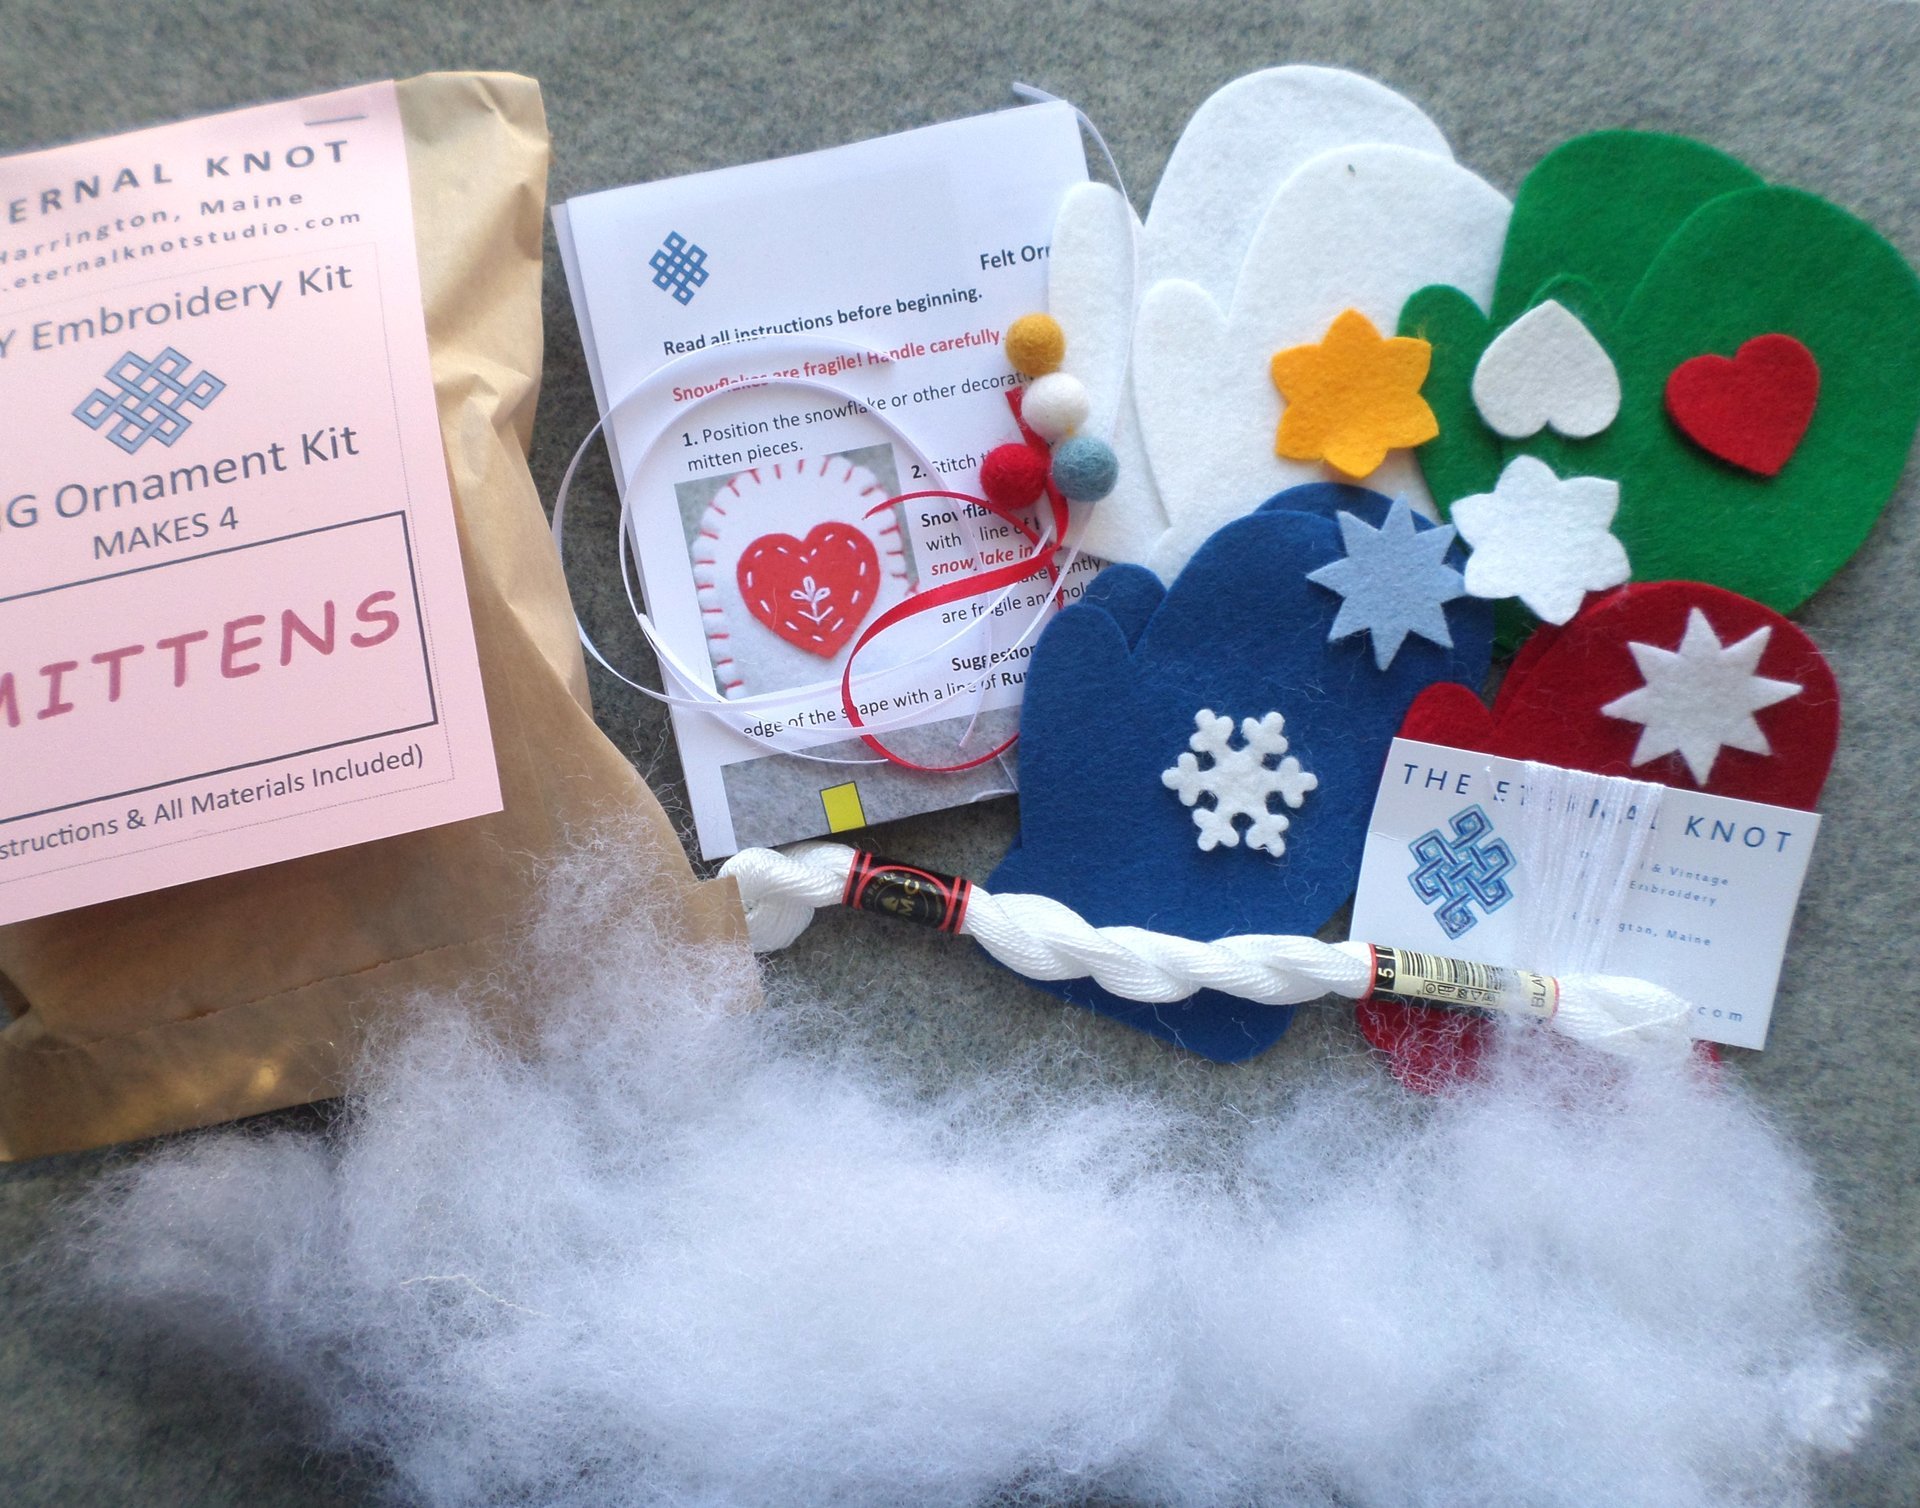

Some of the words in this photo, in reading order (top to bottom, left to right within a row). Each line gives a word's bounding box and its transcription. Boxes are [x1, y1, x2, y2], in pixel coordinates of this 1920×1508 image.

[206, 140, 347, 178] KNOT
[200, 192, 303, 216] Maine
[980, 249, 1016, 270] Felt
[33, 280, 283, 351] Embroidery
[300, 265, 353, 296] Kit
[664, 335, 706, 356] Read
[711, 330, 730, 346] all
[735, 314, 833, 343] instructions
[837, 305, 892, 324] before
[896, 286, 983, 315] beginning.
[803, 353, 862, 378] fragile!
[682, 432, 698, 447] 1.
[703, 415, 769, 443] Position
[773, 406, 801, 428] the
[891, 394, 908, 408] or
[913, 384, 956, 404] other
[688, 450, 743, 472] mitten
[747, 439, 803, 469] pieces.
[911, 464, 927, 480] 2.
[55, 441, 288, 519] Ornament
[300, 426, 360, 466] Kit
[93, 513, 210, 560] MAKES
[219, 506, 240, 530] 4
[926, 532, 962, 552] with
[980, 525, 1009, 541] line
[942, 609, 968, 624] are
[743, 721, 784, 738] edge
[788, 712, 804, 728] of
[808, 709, 836, 725] the
[893, 688, 929, 708] with
[934, 689, 943, 700] a
[126, 808, 146, 831] &
[154, 797, 184, 824] All
[191, 772, 305, 814] Materials
[312, 743, 424, 788] Included)
[1403, 763, 1471, 795] THE
[1685, 815, 1793, 854] KNOT
[1651, 863, 1662, 873] &
[1669, 866, 1729, 887] Vintage
[1667, 929, 1712, 946] Maine
[1377, 967, 1395, 979] 5
